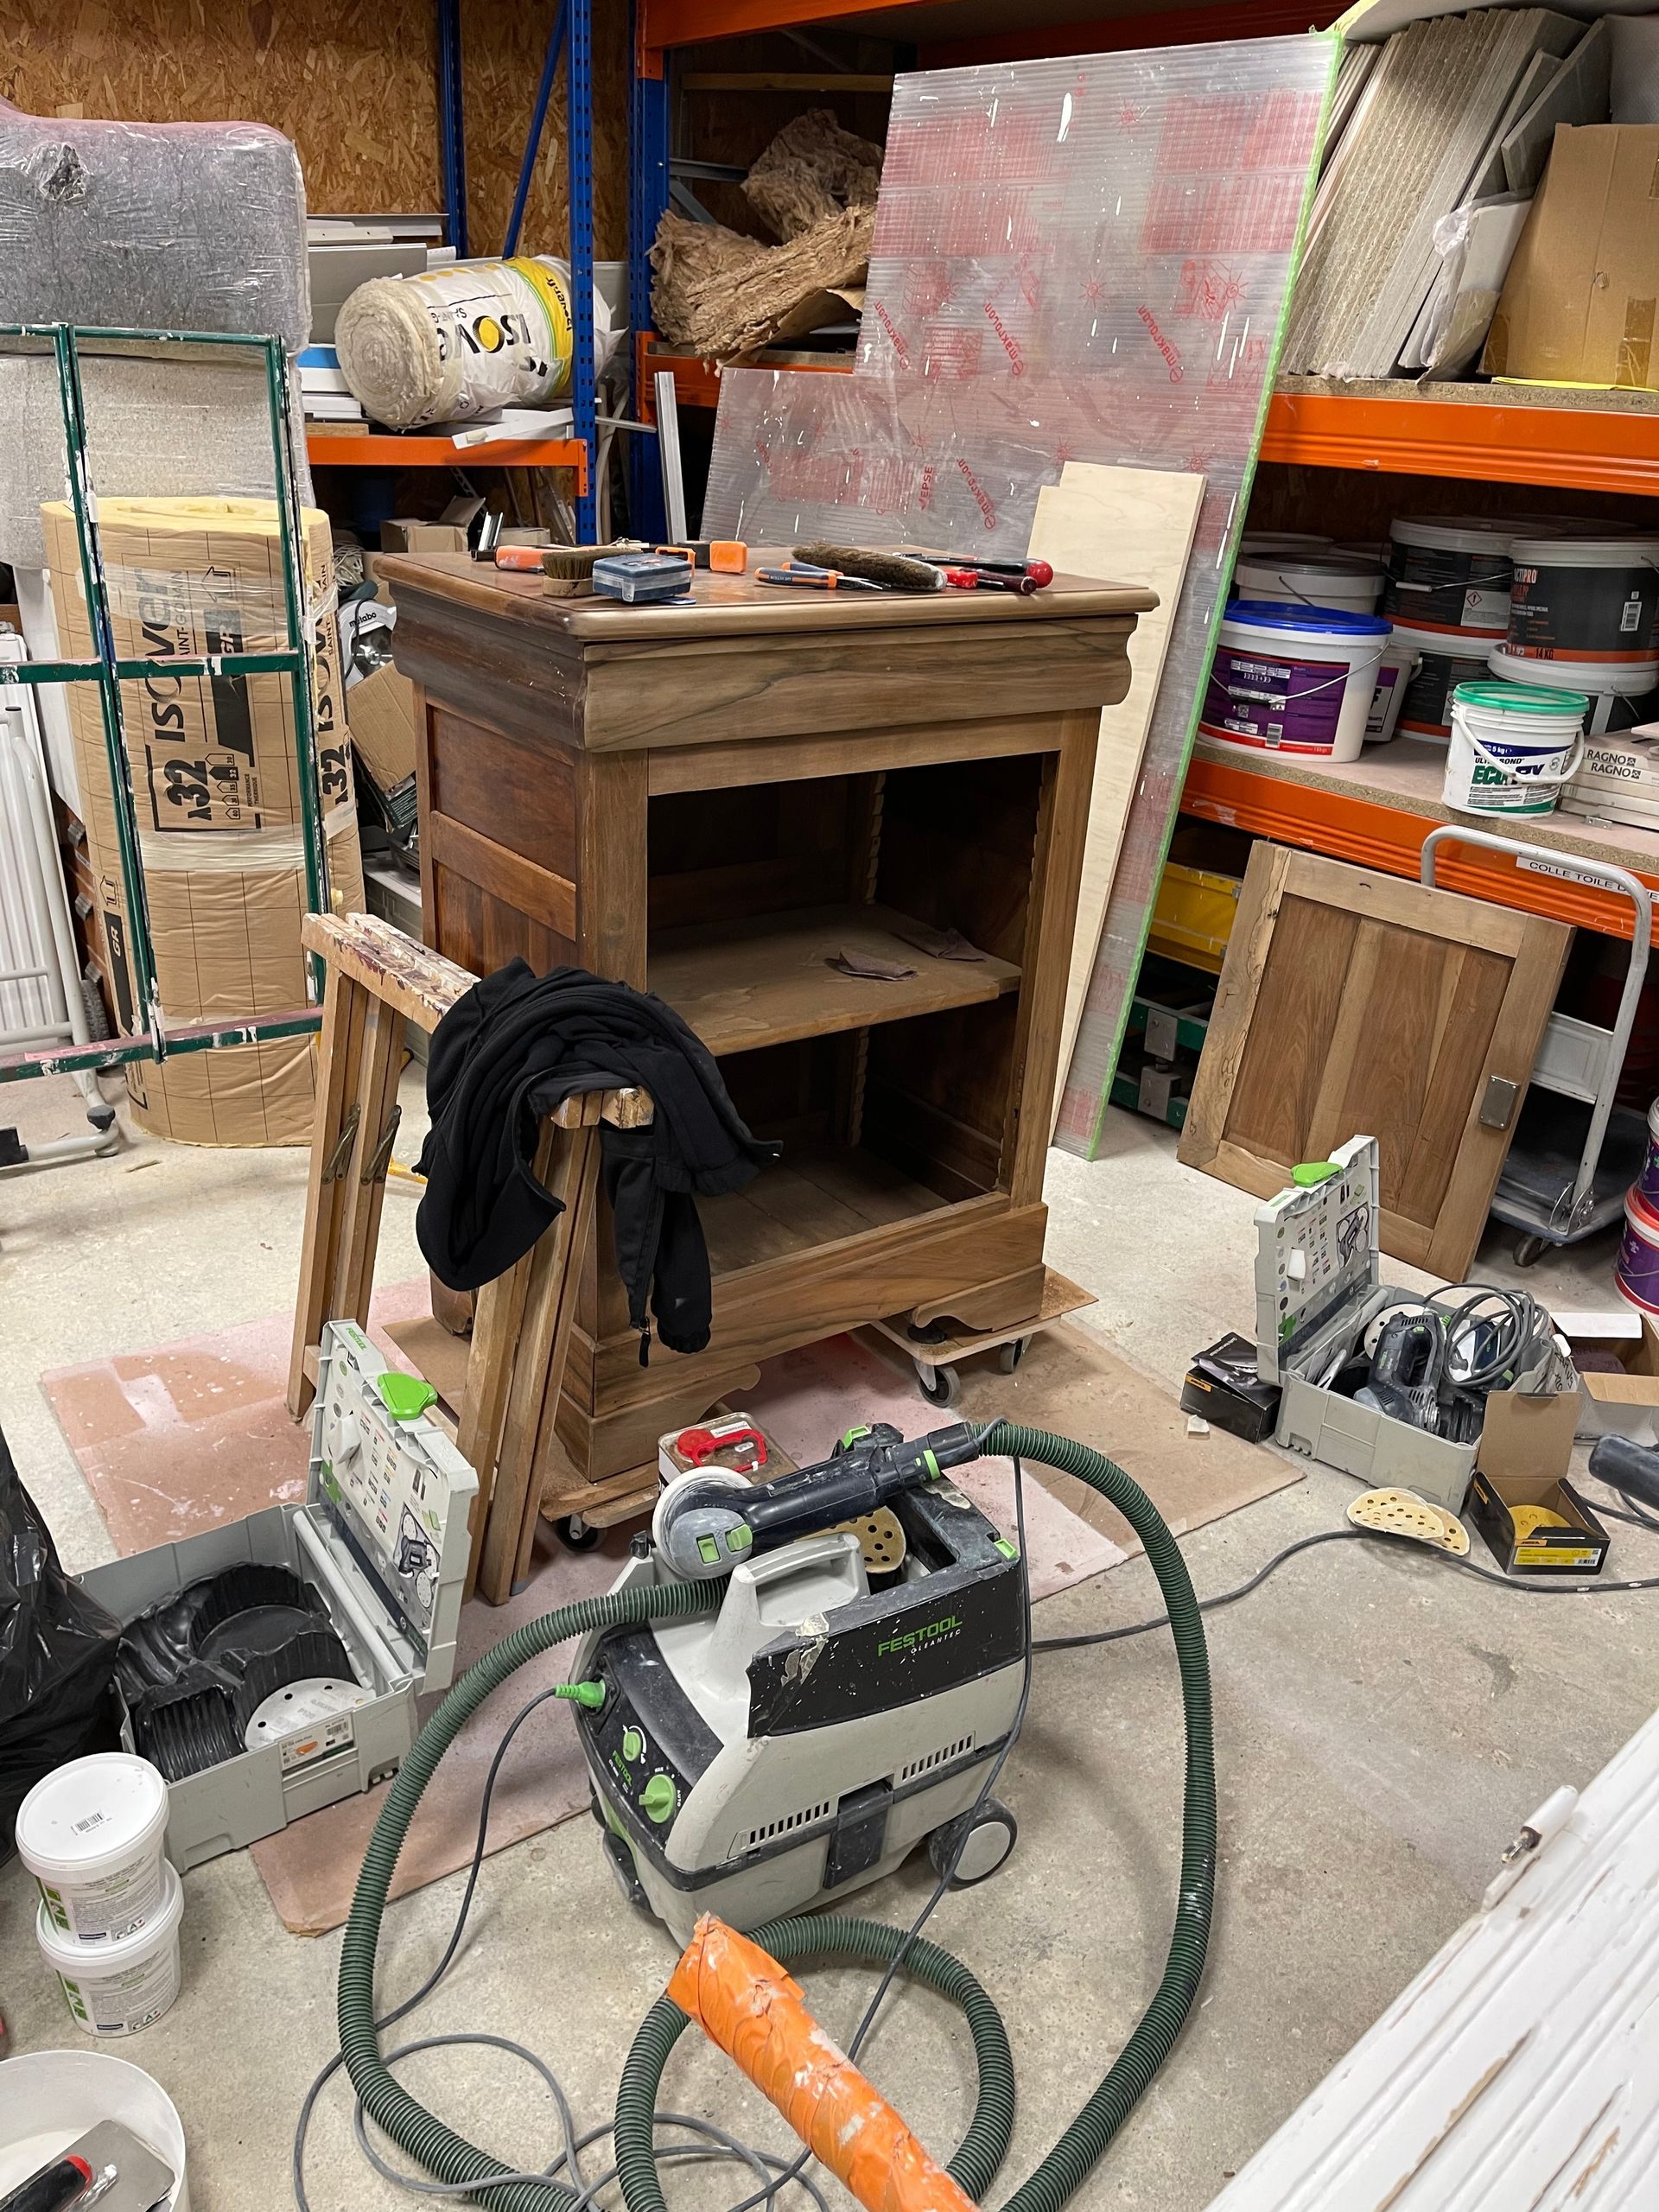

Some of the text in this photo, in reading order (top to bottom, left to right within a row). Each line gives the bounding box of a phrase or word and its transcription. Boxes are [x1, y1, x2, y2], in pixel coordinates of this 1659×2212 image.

[874, 302, 906, 355] makrolon
[984, 302, 1018, 360] makrolon
[1136, 304, 1177, 366] makrolon
[957, 458, 992, 514] makrolon
[171, 570, 190, 657] AINT-GOBAIN
[349, 612, 377, 627] mtabo
[1586, 749, 1626, 765] RAGNO
[1591, 762, 1631, 778] RAGNO
[229, 769, 236, 778] 32
[1529, 861, 1570, 878] COLLE
[1575, 873, 1613, 888] TOILE
[111, 925, 121, 957] GR
[346, 1326, 367, 1351] FESTOOL
[877, 1615, 963, 1657] FESTOOL
[911, 1629, 961, 1654] CLEANTEC
